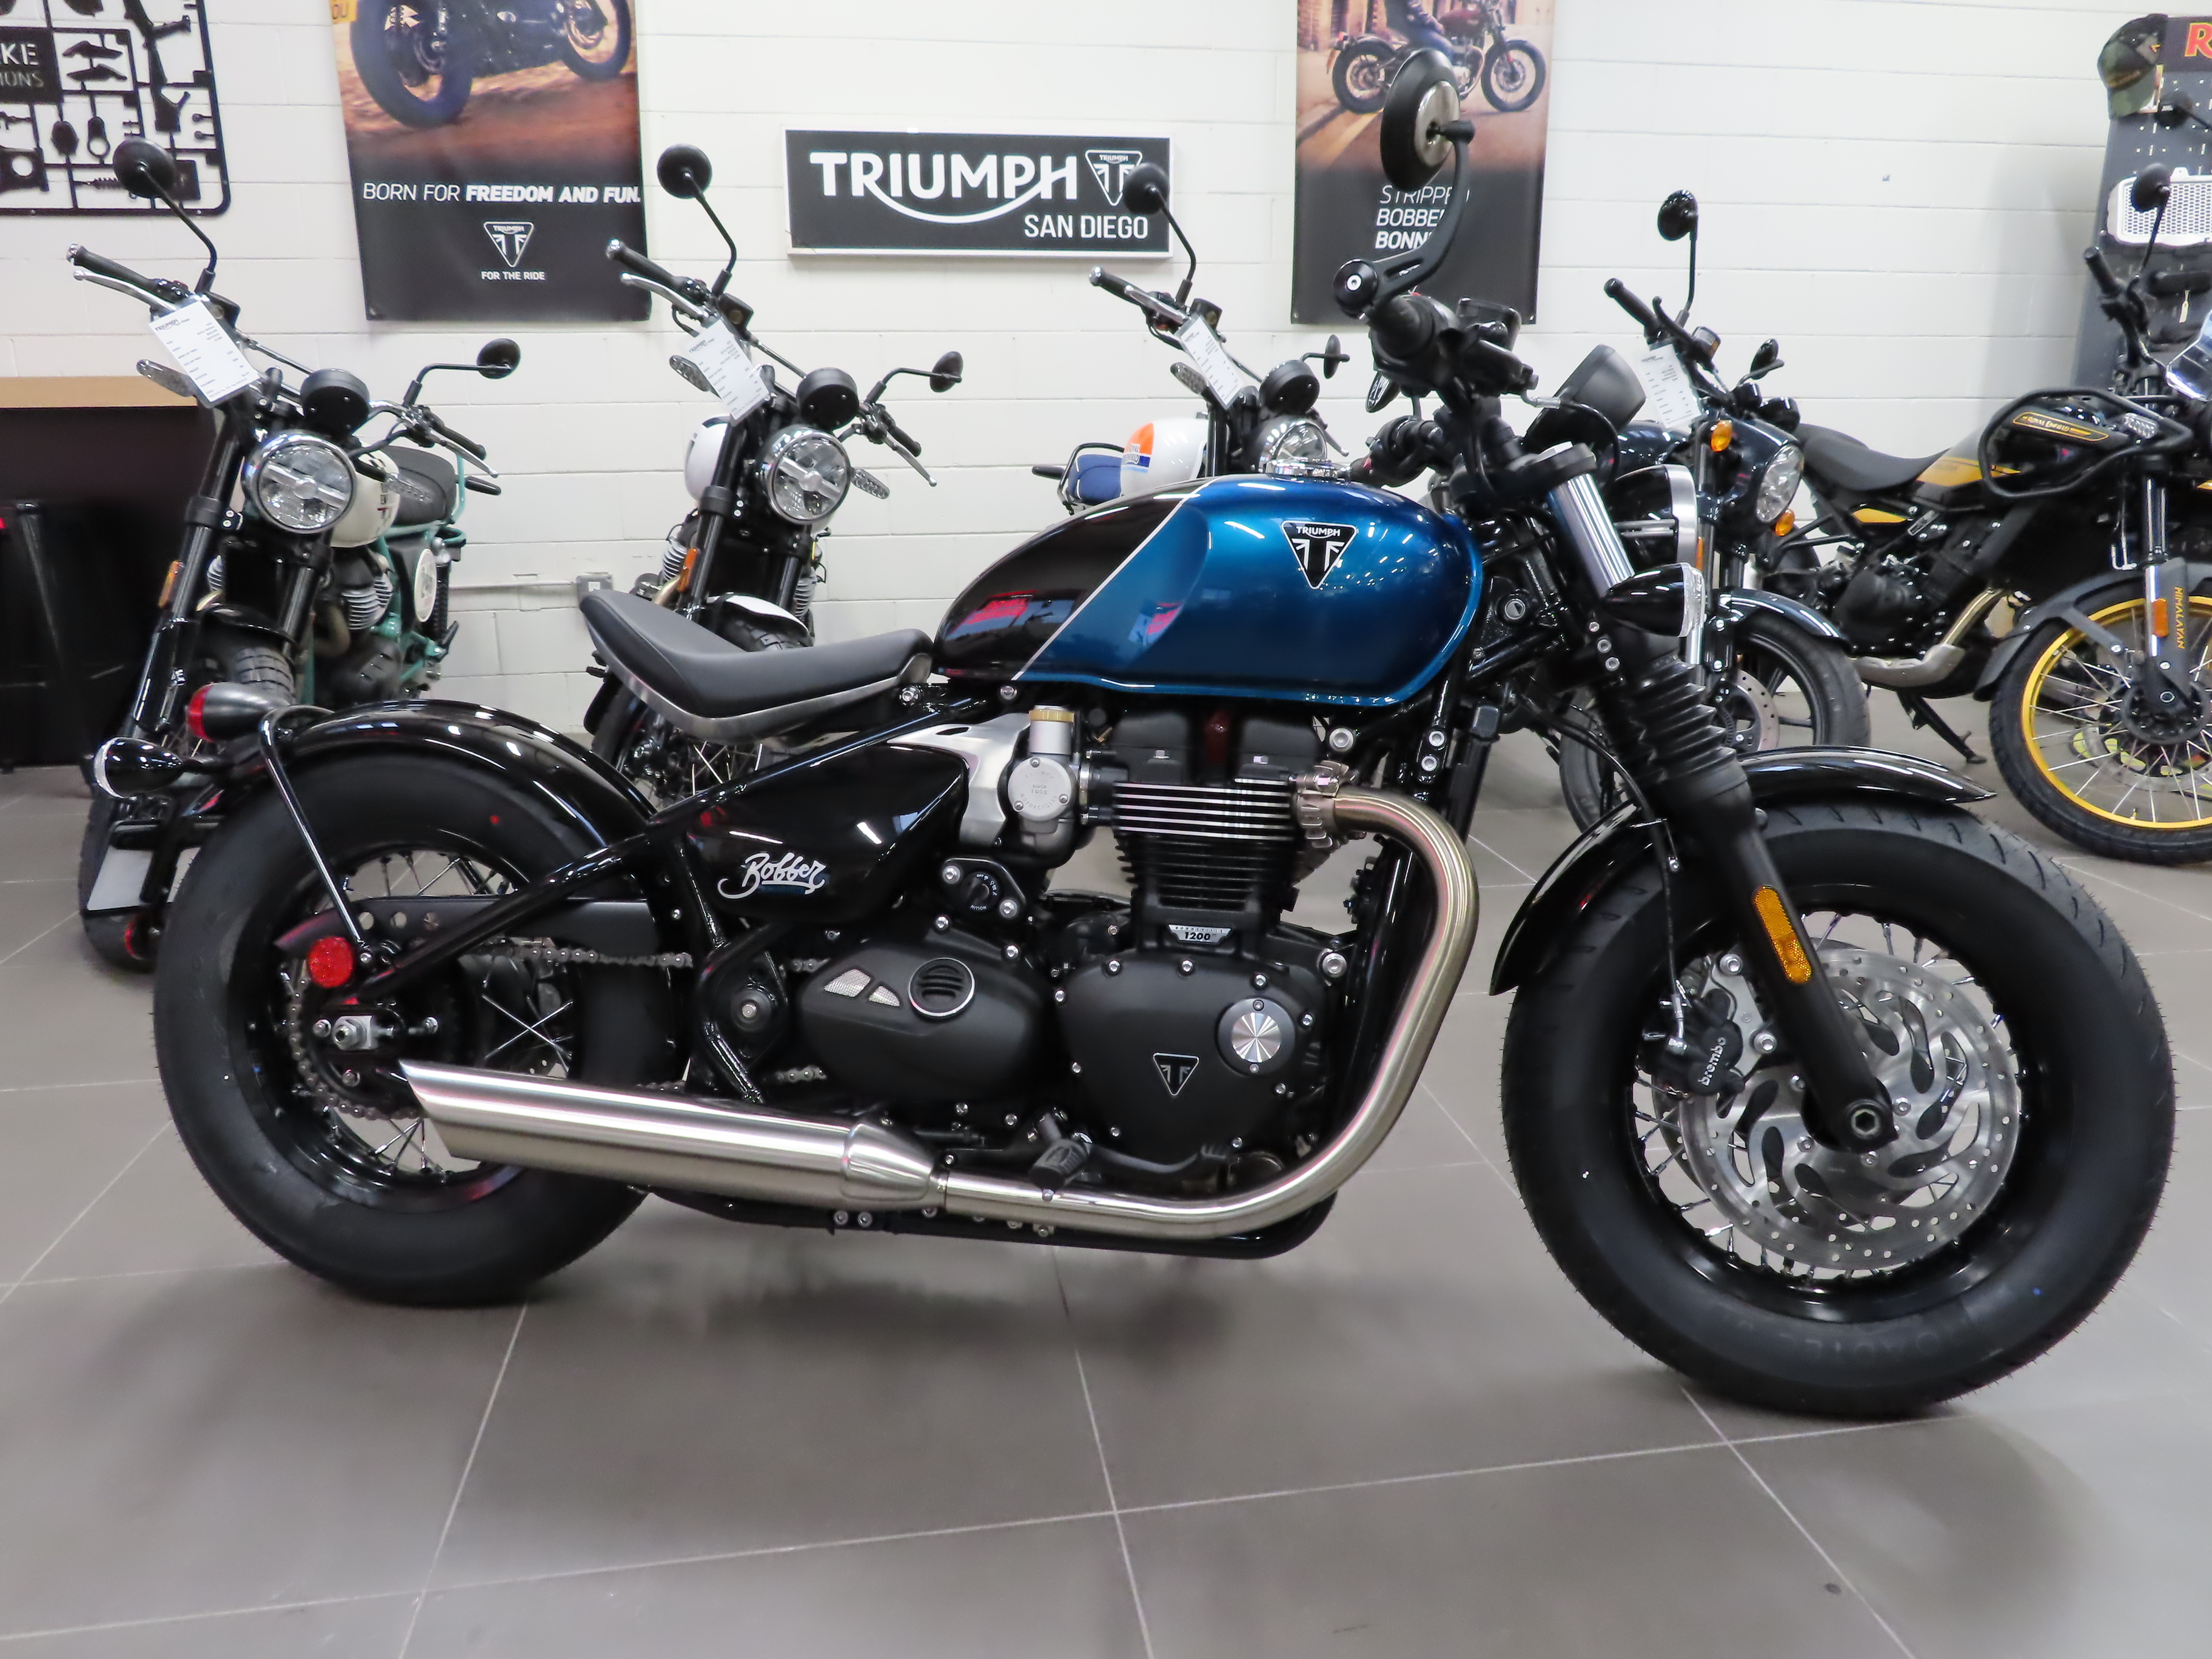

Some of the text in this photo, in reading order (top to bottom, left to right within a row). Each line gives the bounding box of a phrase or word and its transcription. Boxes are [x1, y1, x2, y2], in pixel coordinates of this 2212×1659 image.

[1099, 154, 1128, 164] TRIUMPH
[364, 183, 641, 204] BORN FOR FREEDOM AND FUN.
[810, 152, 1078, 224] TRIUMPH
[1380, 185, 1470, 204] SRIPP
[1024, 215, 1148, 240] SAN DIEGO
[481, 271, 545, 280] FOR THE RIDE
[1296, 526, 1341, 538] TRIUMPH
[2174, 586, 2185, 649] HIMALAYAN
[717, 853, 827, 899] Bobber
[1185, 932, 1211, 940] 1200
[1698, 1037, 1726, 1087] brembo
